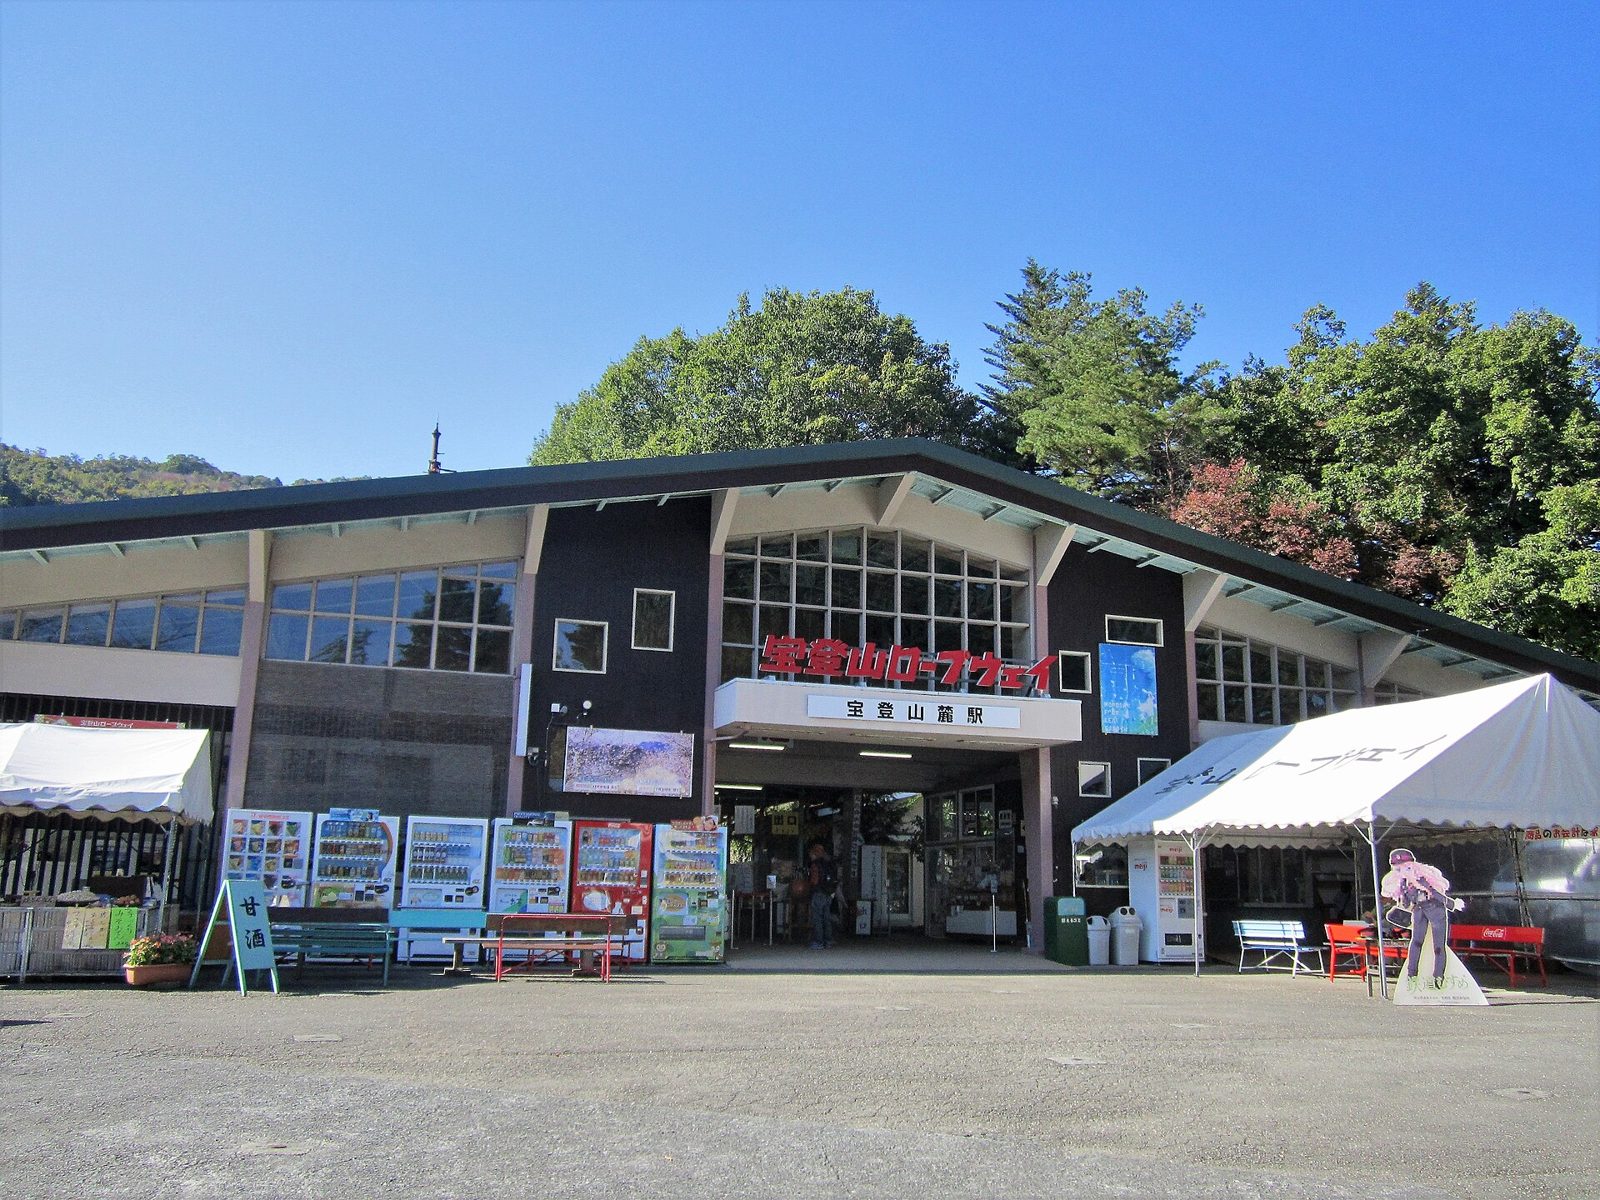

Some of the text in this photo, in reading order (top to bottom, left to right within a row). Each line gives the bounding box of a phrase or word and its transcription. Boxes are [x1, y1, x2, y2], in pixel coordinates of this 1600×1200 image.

[758, 634, 1057, 691] 宝登山ロープウェイ
[846, 699, 984, 725] 宝登山麓駅
[239, 895, 266, 950] 甘酒
